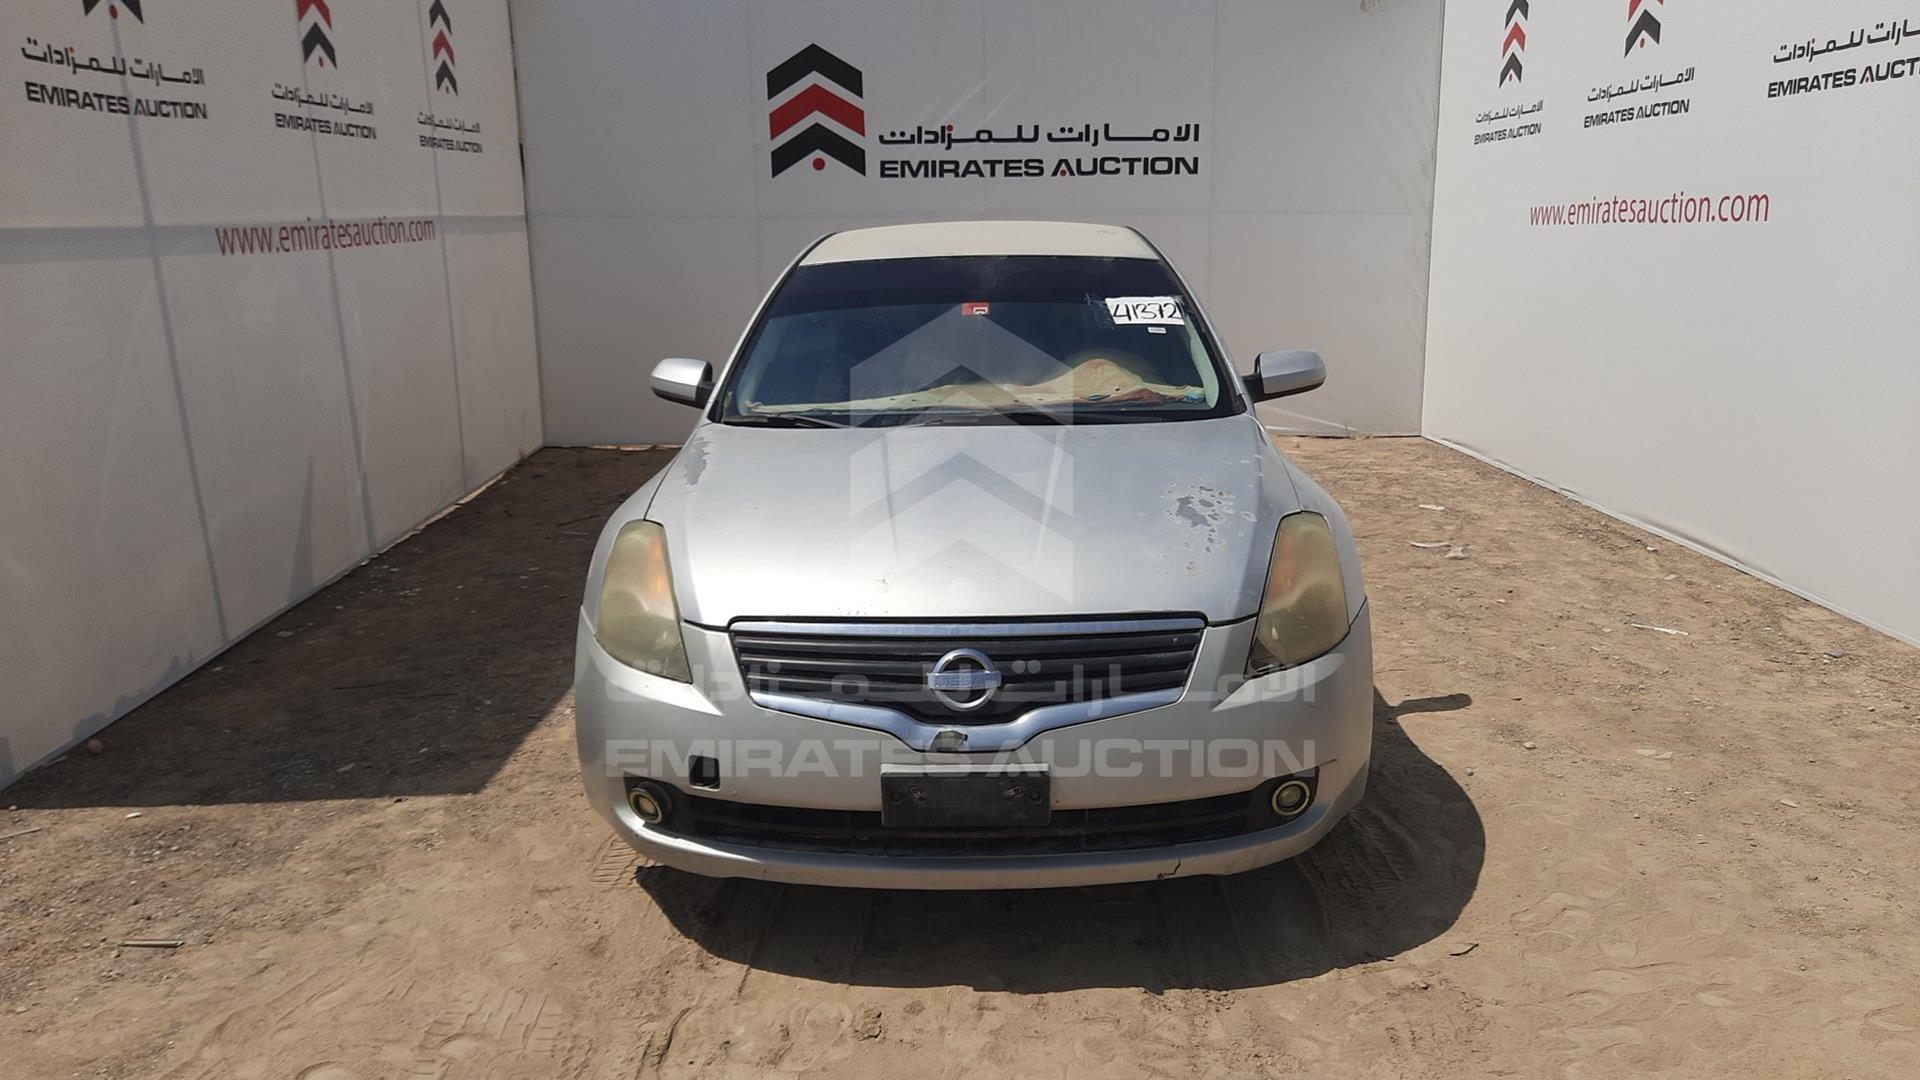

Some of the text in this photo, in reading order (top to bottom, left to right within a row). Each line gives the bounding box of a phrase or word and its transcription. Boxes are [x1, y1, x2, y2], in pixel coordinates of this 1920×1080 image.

[1768, 57, 1920, 98] EMIRATES AUCT
[25, 82, 207, 119] EMIRATES AUCTION
[1584, 98, 1690, 129] EMIRATES AUCTION
[275, 113, 377, 140] EMIRATES AUCTION
[879, 124, 1199, 150] الامارات للمزادات
[1474, 122, 1542, 144] EMIRATES AUCTION
[420, 135, 482, 154] EMIRATES AUCTION
[880, 157, 1198, 178] EMIRATES AUCTION
[1530, 190, 1770, 226] www.emiratesauction.com
[215, 215, 436, 256] www.emiratesauction.com
[1113, 302, 1184, 321] 41372
